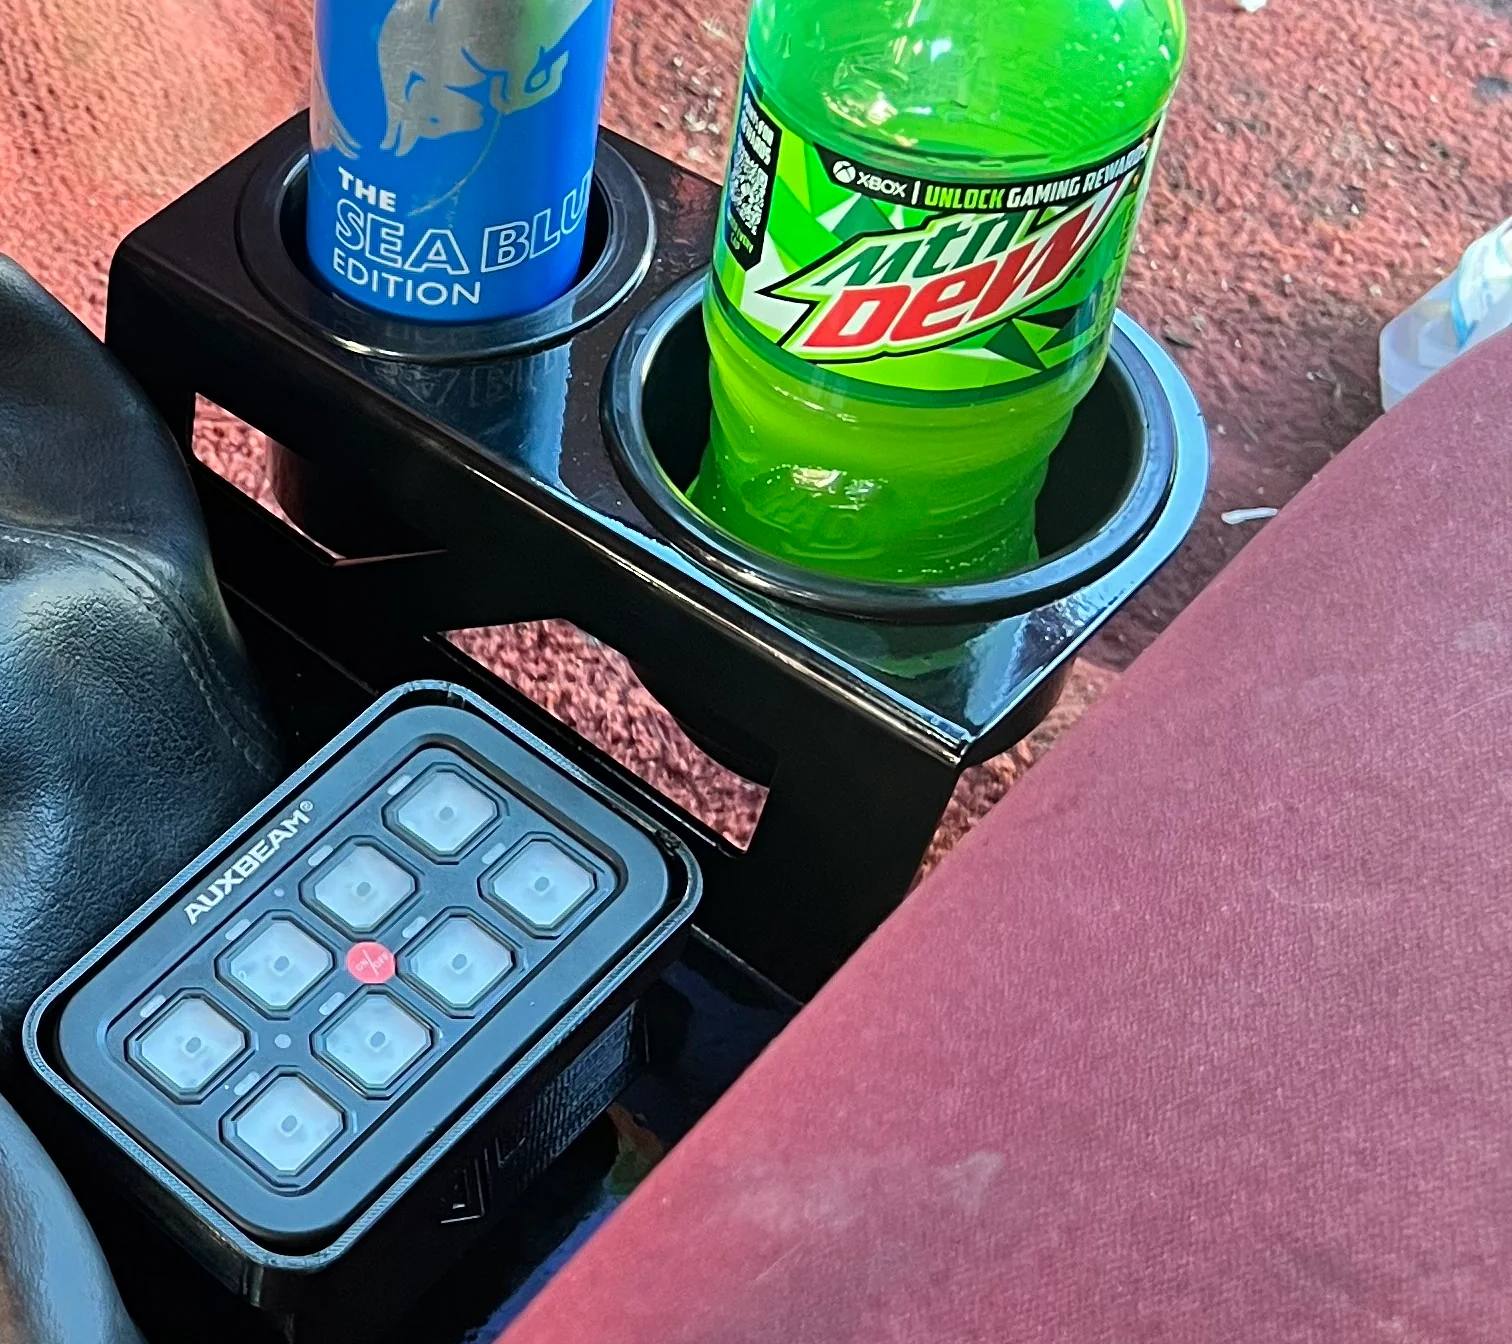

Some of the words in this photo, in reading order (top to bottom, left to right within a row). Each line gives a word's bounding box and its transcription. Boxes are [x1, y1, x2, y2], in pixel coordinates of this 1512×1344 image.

[337, 166, 397, 213] THE
[856, 170, 908, 198] XBOX
[925, 184, 1005, 210] UNLOCK
[1006, 176, 1081, 209] GAMING
[335, 198, 470, 276] SEA
[333, 247, 481, 306] EDITION
